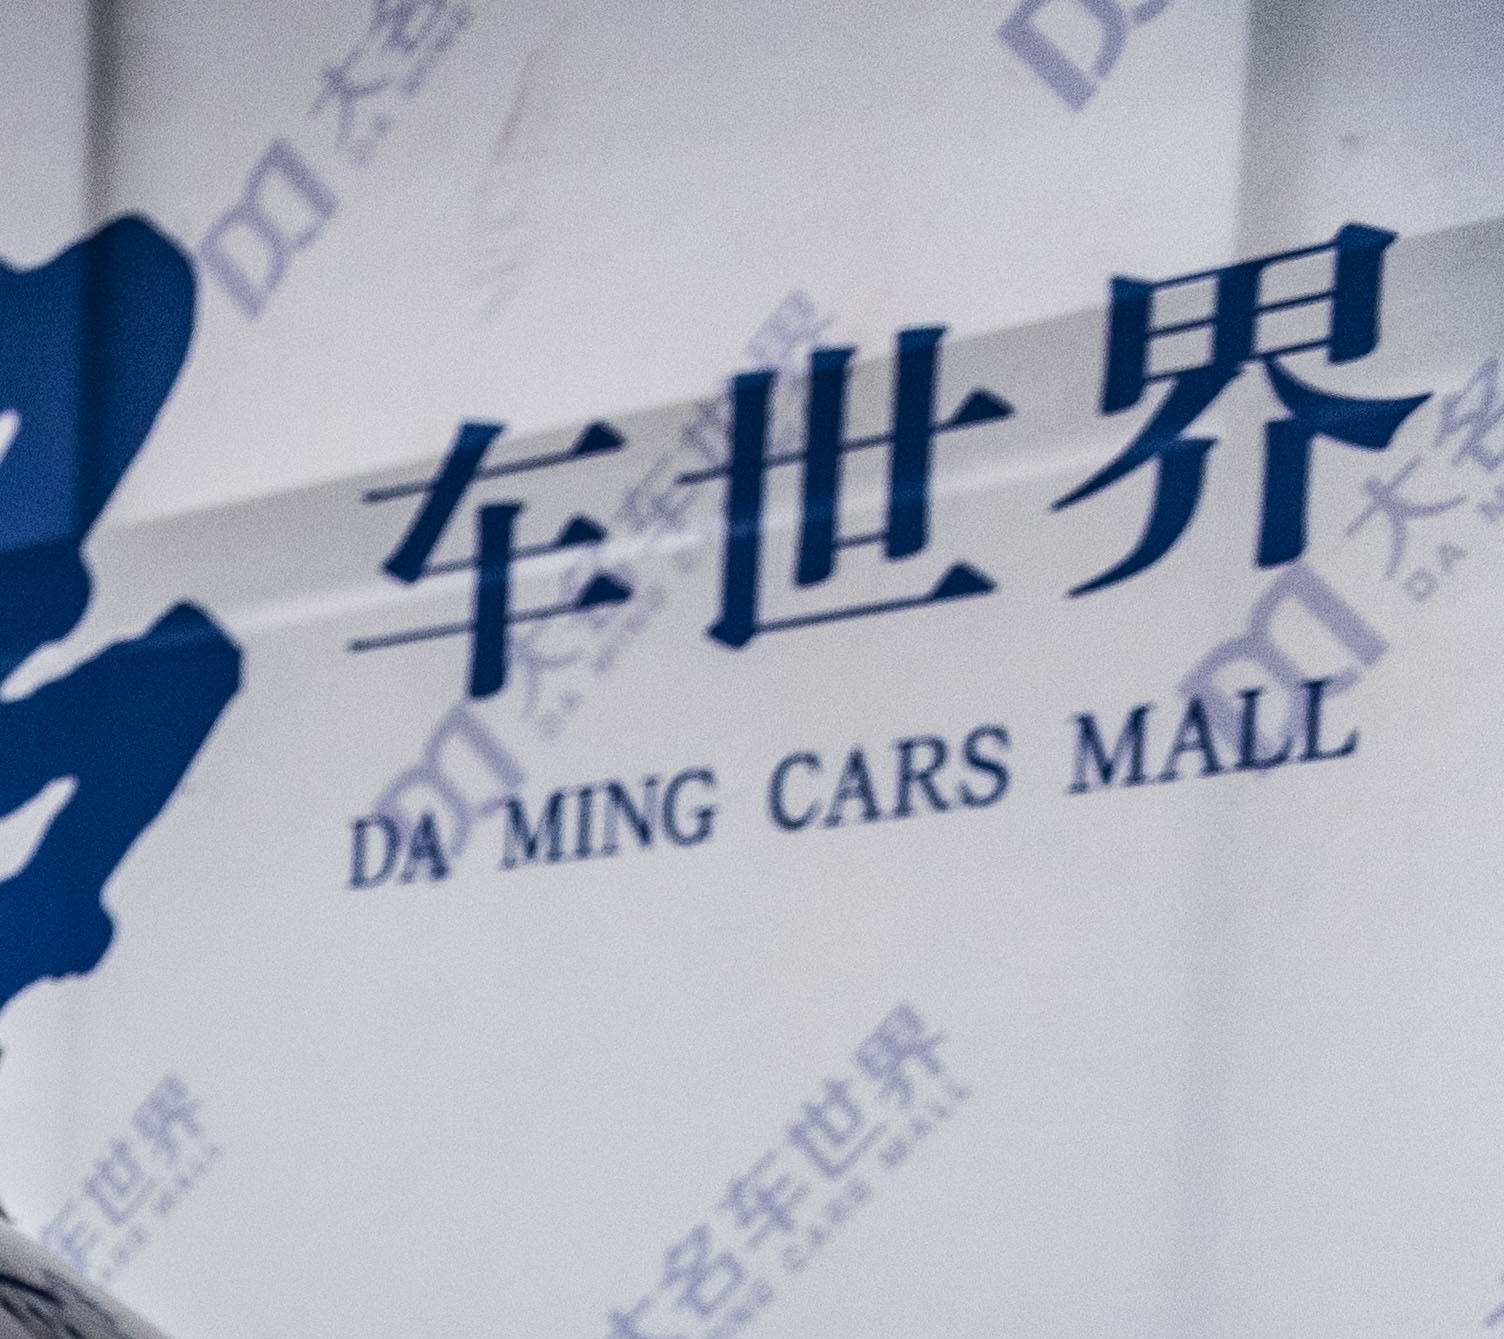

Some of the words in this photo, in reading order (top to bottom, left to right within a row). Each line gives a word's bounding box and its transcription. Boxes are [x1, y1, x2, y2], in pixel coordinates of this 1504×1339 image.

[347, 220, 1434, 700] 车世界
[348, 807, 451, 892] DA
[498, 765, 719, 872] MING
[766, 721, 1014, 835] CARS
[1064, 675, 1362, 797] MALL
